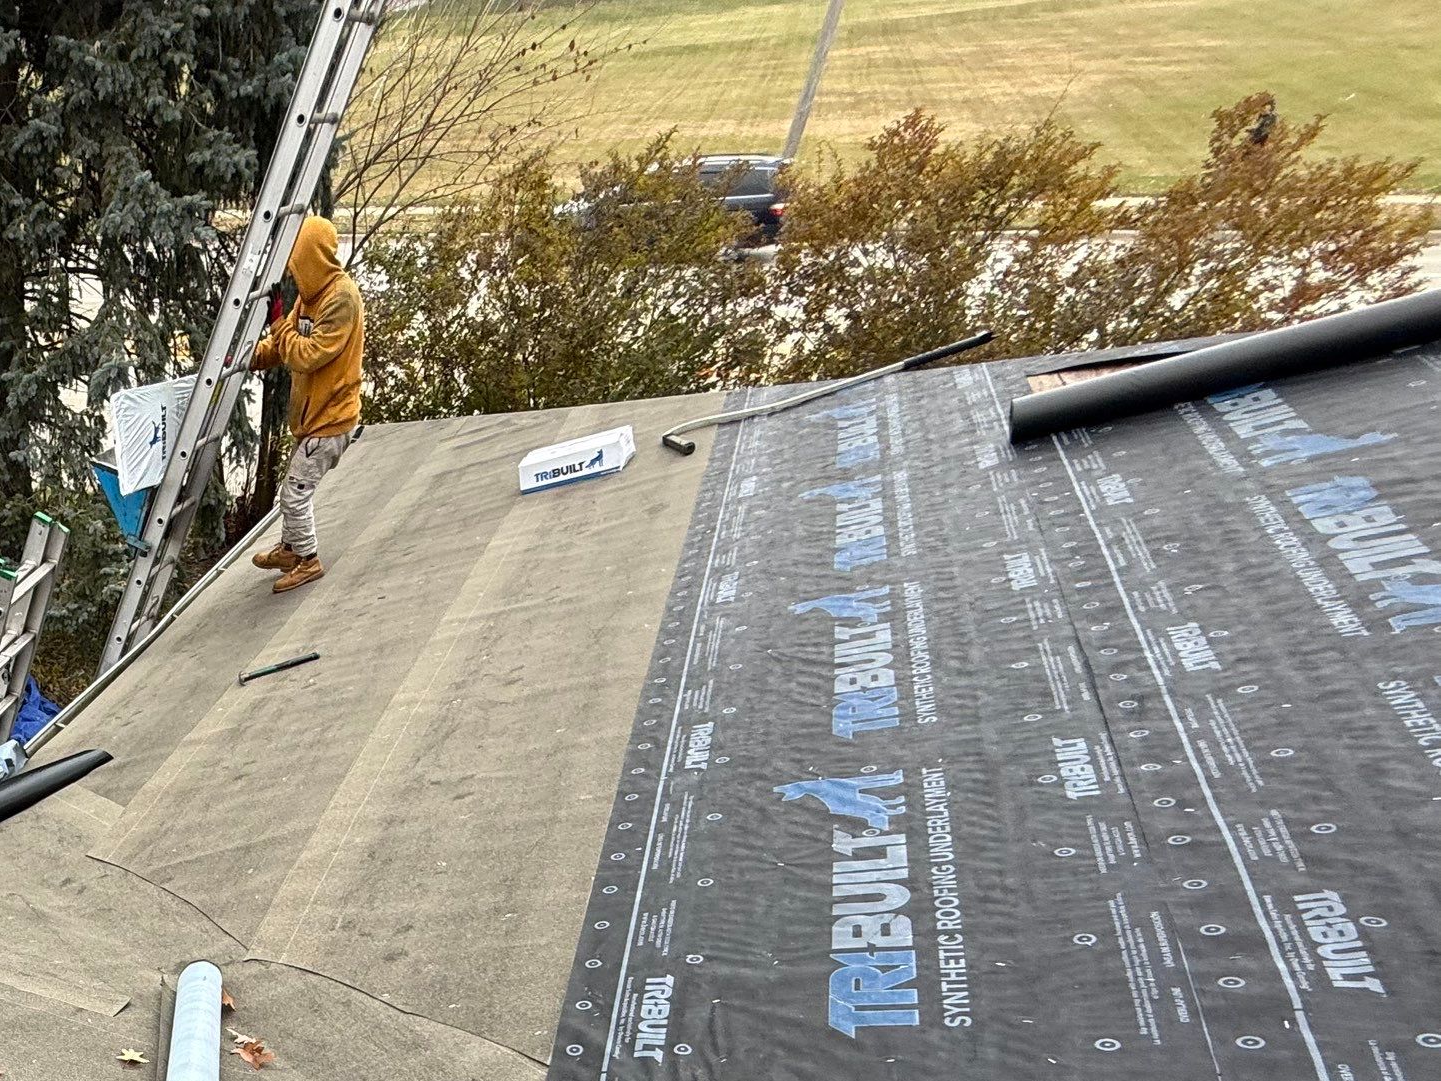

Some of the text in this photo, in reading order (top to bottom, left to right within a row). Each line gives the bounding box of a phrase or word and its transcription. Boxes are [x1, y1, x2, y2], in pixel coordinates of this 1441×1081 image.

[534, 461, 586, 483] TRIBUILT
[1285, 476, 1441, 581] TRIBUILT
[832, 622, 900, 739] TRIBUILT
[903, 581, 937, 723] SYNTHETIC ROOFING UNDERLAYMENT
[1166, 622, 1222, 671] TRIBUILT
[684, 721, 715, 770] TRIBUILT
[1051, 736, 1102, 800] TRIBUILT
[828, 829, 920, 1039] TRIBUILT
[922, 768, 971, 1026] SYNTHETIC ROOFING UNDERLAYMENT
[1293, 889, 1385, 995] TRIBUILT
[633, 974, 676, 1063] TRIBUILT
